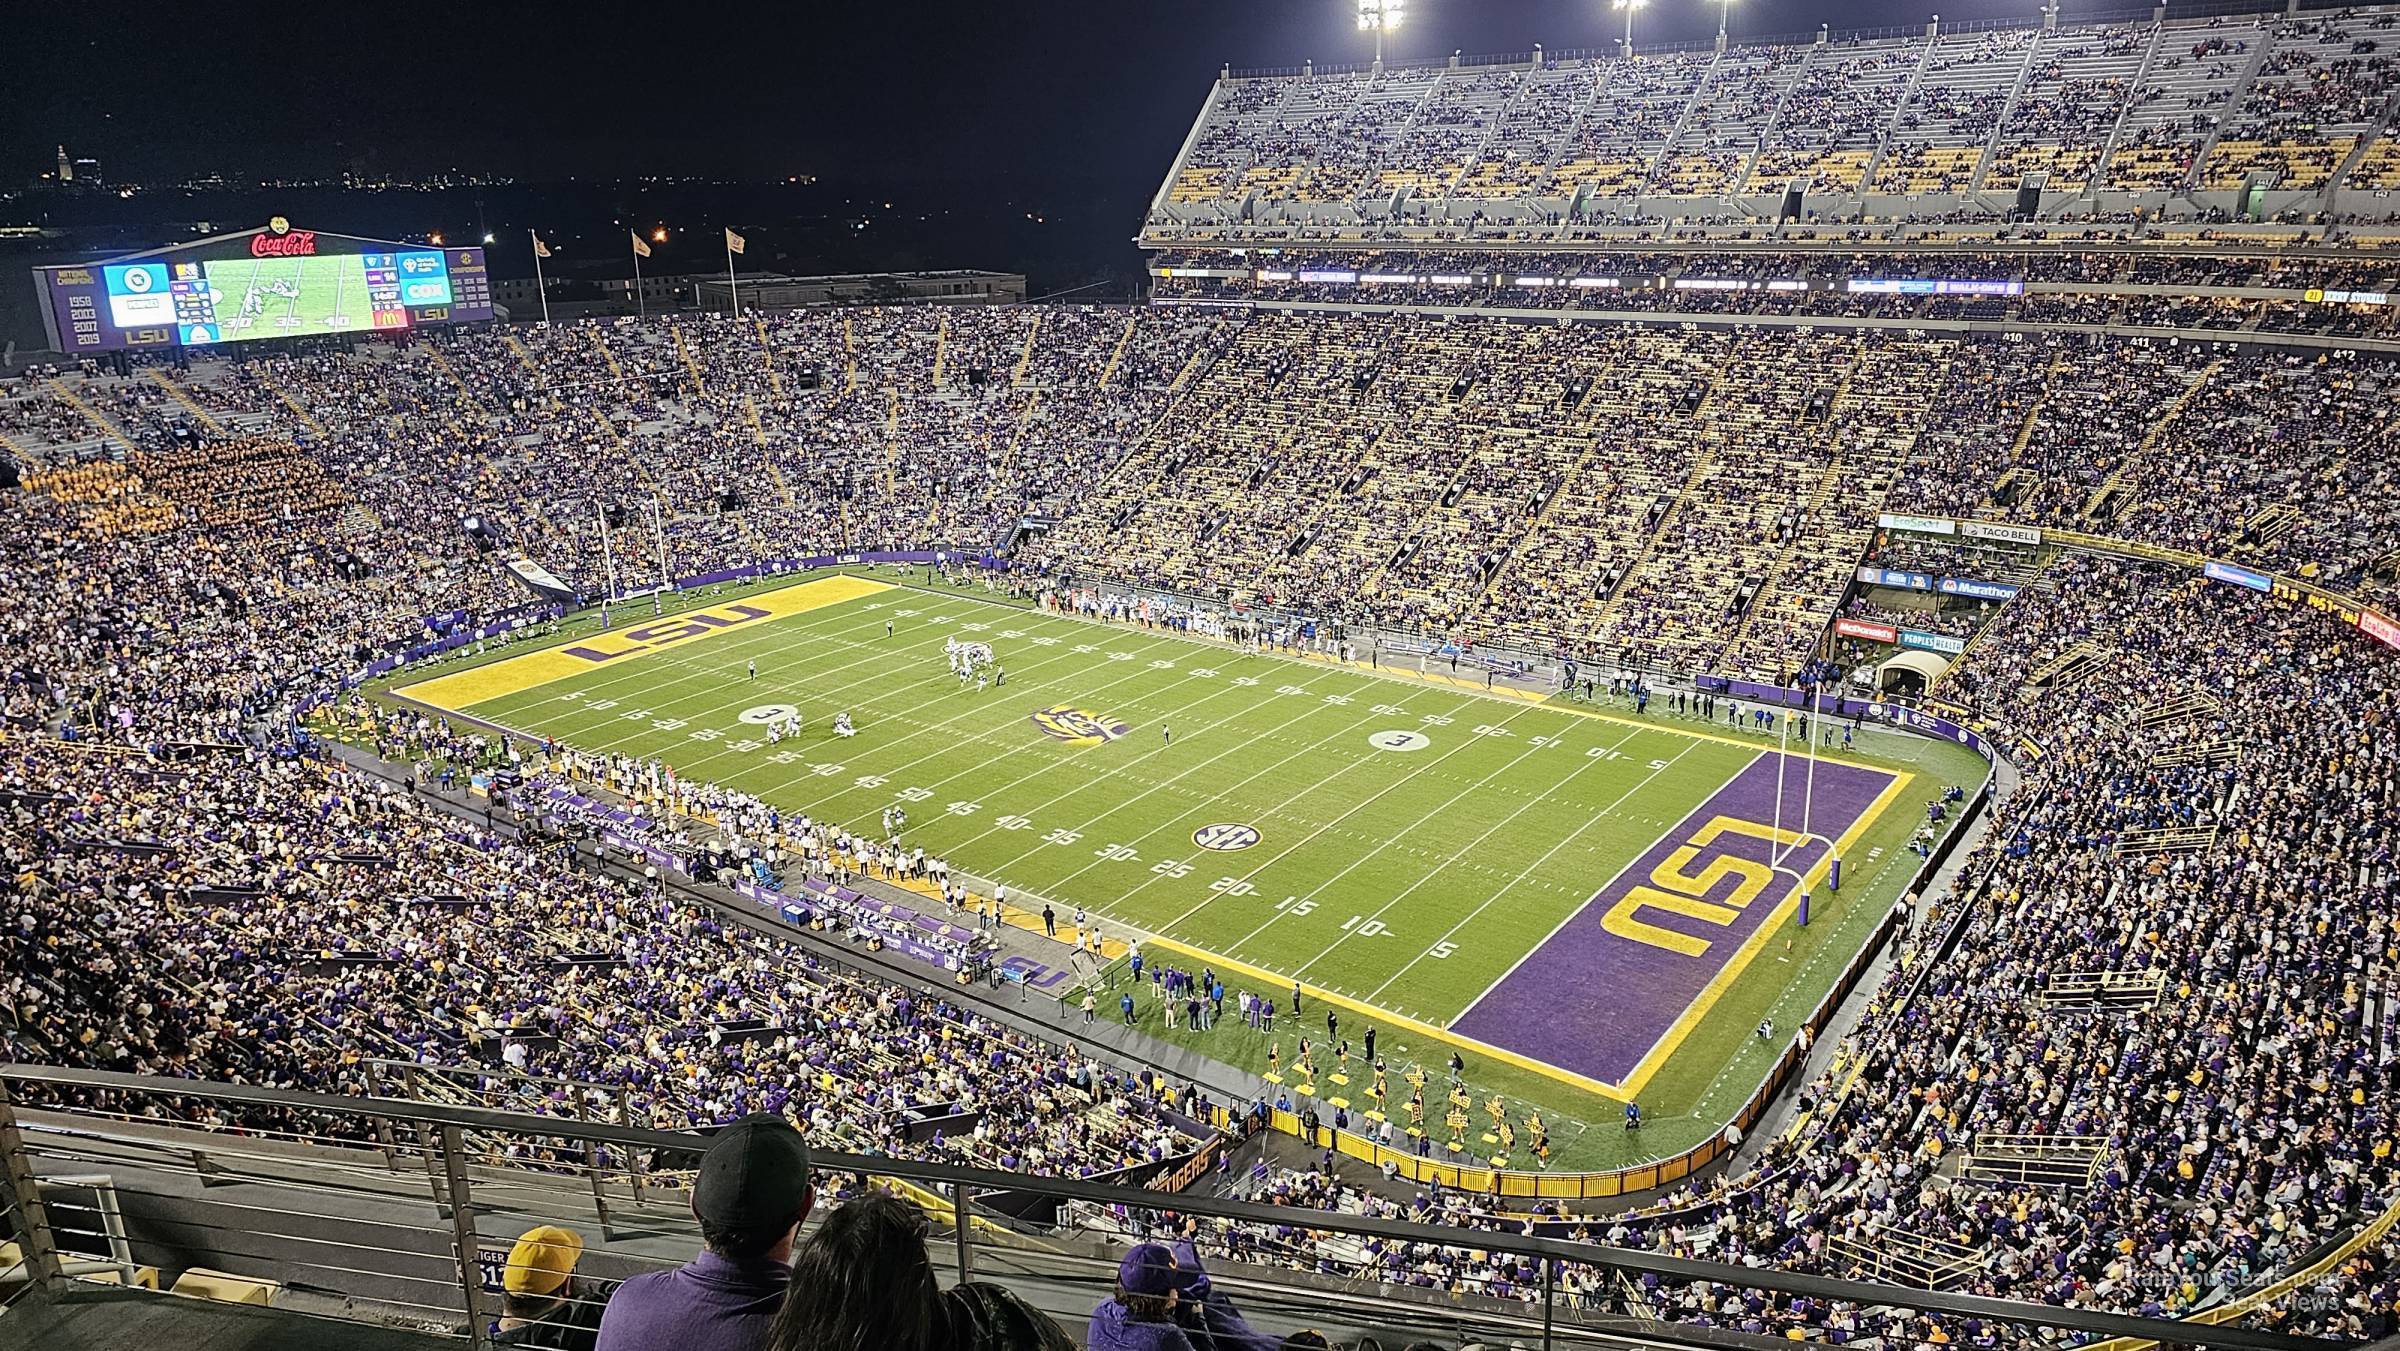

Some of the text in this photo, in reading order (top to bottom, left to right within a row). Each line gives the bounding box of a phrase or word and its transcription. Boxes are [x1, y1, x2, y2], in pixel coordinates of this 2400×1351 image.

[69, 296, 92, 307] 1958
[70, 308, 96, 320] 2003
[415, 307, 449, 321] LSU
[73, 321, 97, 332] 2007
[1557, 318, 1573, 326] 303
[1680, 322, 1698, 331] 304
[1795, 325, 1813, 334] 305
[1906, 329, 1926, 337] 306
[76, 333, 100, 345] 2019
[125, 328, 170, 345] LSU
[2002, 332, 2023, 342] 410
[2130, 336, 2150, 348] 411
[1983, 527, 2036, 541] TACO BELL
[837, 554, 861, 564] LSU
[1958, 582, 2015, 599] Marathon
[561, 604, 772, 662] LSU
[1904, 634, 1934, 646] PEOPLES
[561, 691, 586, 701] 5
[585, 699, 619, 710] 10
[1369, 704, 1404, 715] 30
[619, 708, 653, 720] 15
[1418, 714, 1456, 726] 25
[652, 718, 689, 731] 20
[1471, 724, 1510, 737] 20
[688, 728, 726, 741] 25
[1384, 734, 1414, 747] 3
[726, 739, 764, 752] 30
[1527, 735, 1562, 748] 15
[766, 750, 804, 764] 35
[1585, 747, 1622, 760] 10
[811, 763, 846, 776] 40
[1645, 759, 1668, 770] 5
[854, 775, 890, 789] 45
[894, 786, 935, 802] 50
[945, 800, 983, 816] 45
[994, 814, 1032, 831] 40
[1040, 828, 1085, 846] 35
[1195, 823, 1257, 850] SEC
[1094, 843, 1138, 862] 30
[1150, 859, 1196, 879] 25
[1208, 876, 1255, 897] 20
[1600, 814, 1813, 958] LSU
[1274, 896, 1320, 917] 15
[1340, 915, 1387, 937] 10
[1429, 941, 1460, 959] 5
[1155, 1139, 1220, 1194] TIGERS
